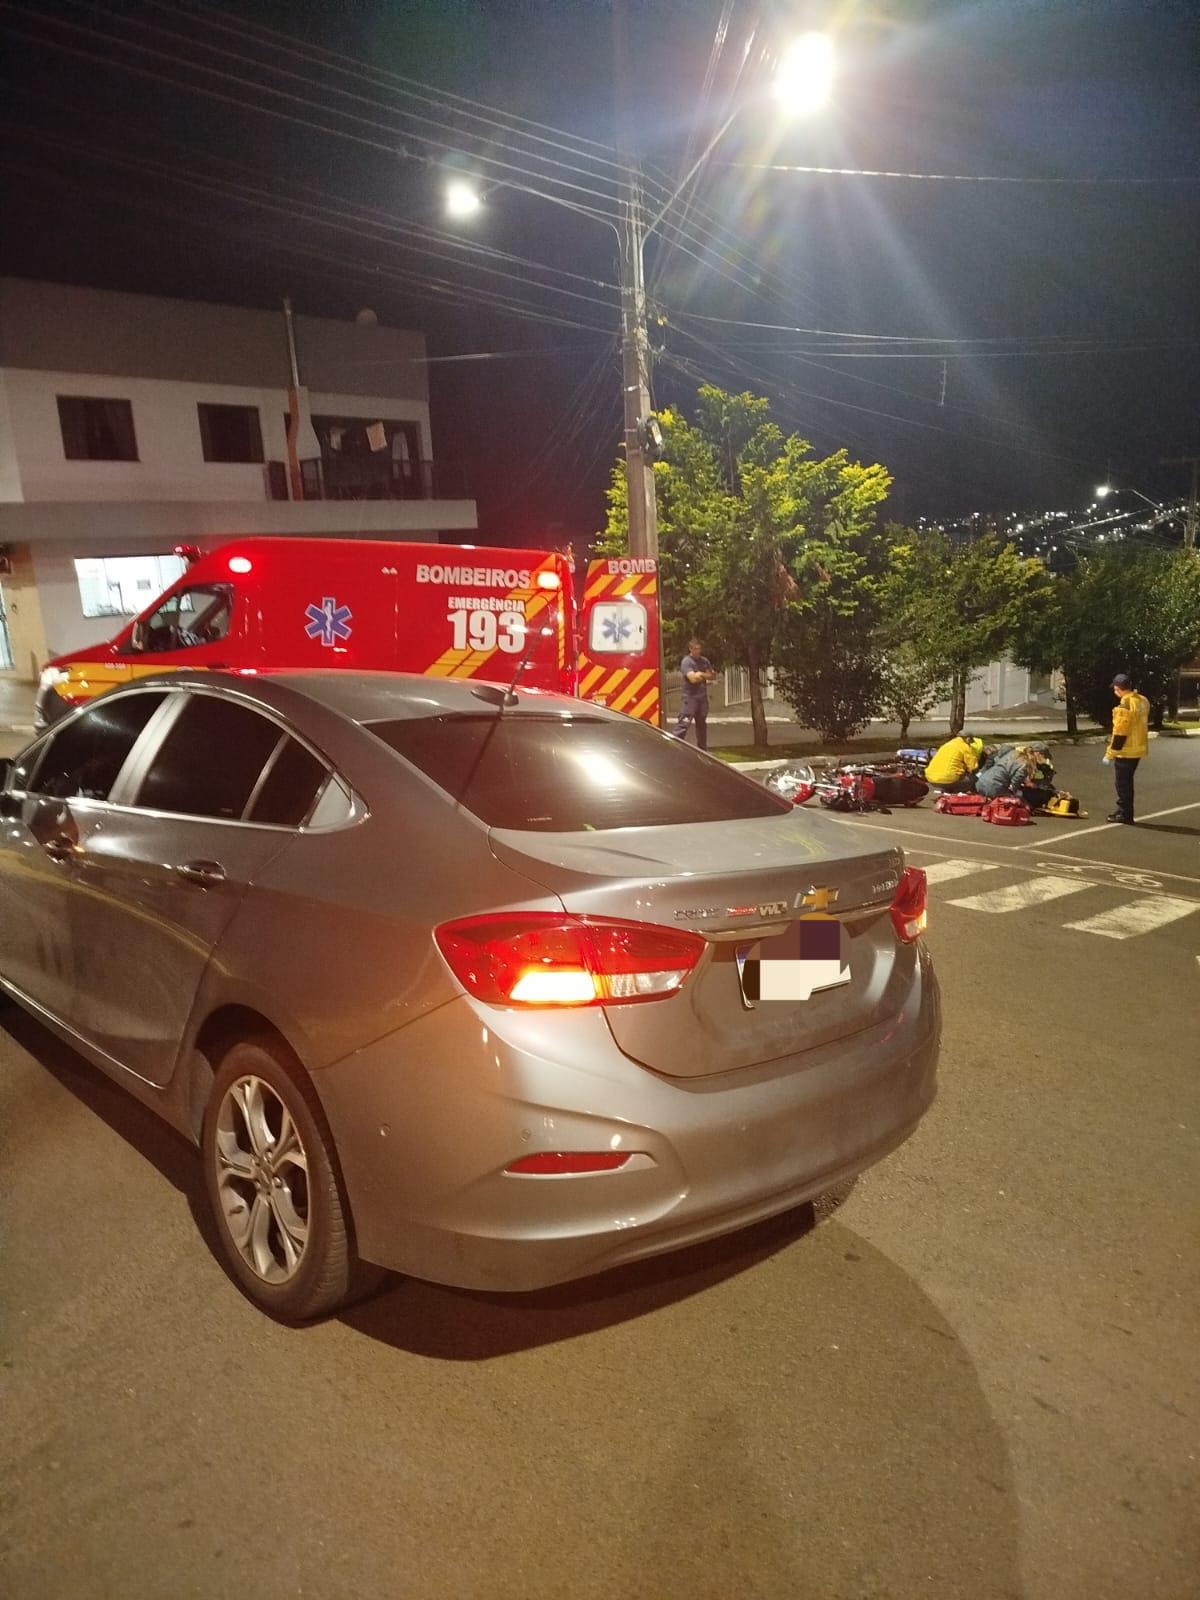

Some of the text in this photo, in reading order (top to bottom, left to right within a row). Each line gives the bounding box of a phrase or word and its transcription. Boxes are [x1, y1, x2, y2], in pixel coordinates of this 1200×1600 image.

[416, 564, 530, 589] BOMBEIROS
[607, 559, 656, 574] BOMB
[448, 596, 525, 612] EMERGÊNCIA
[447, 611, 526, 653] 193
